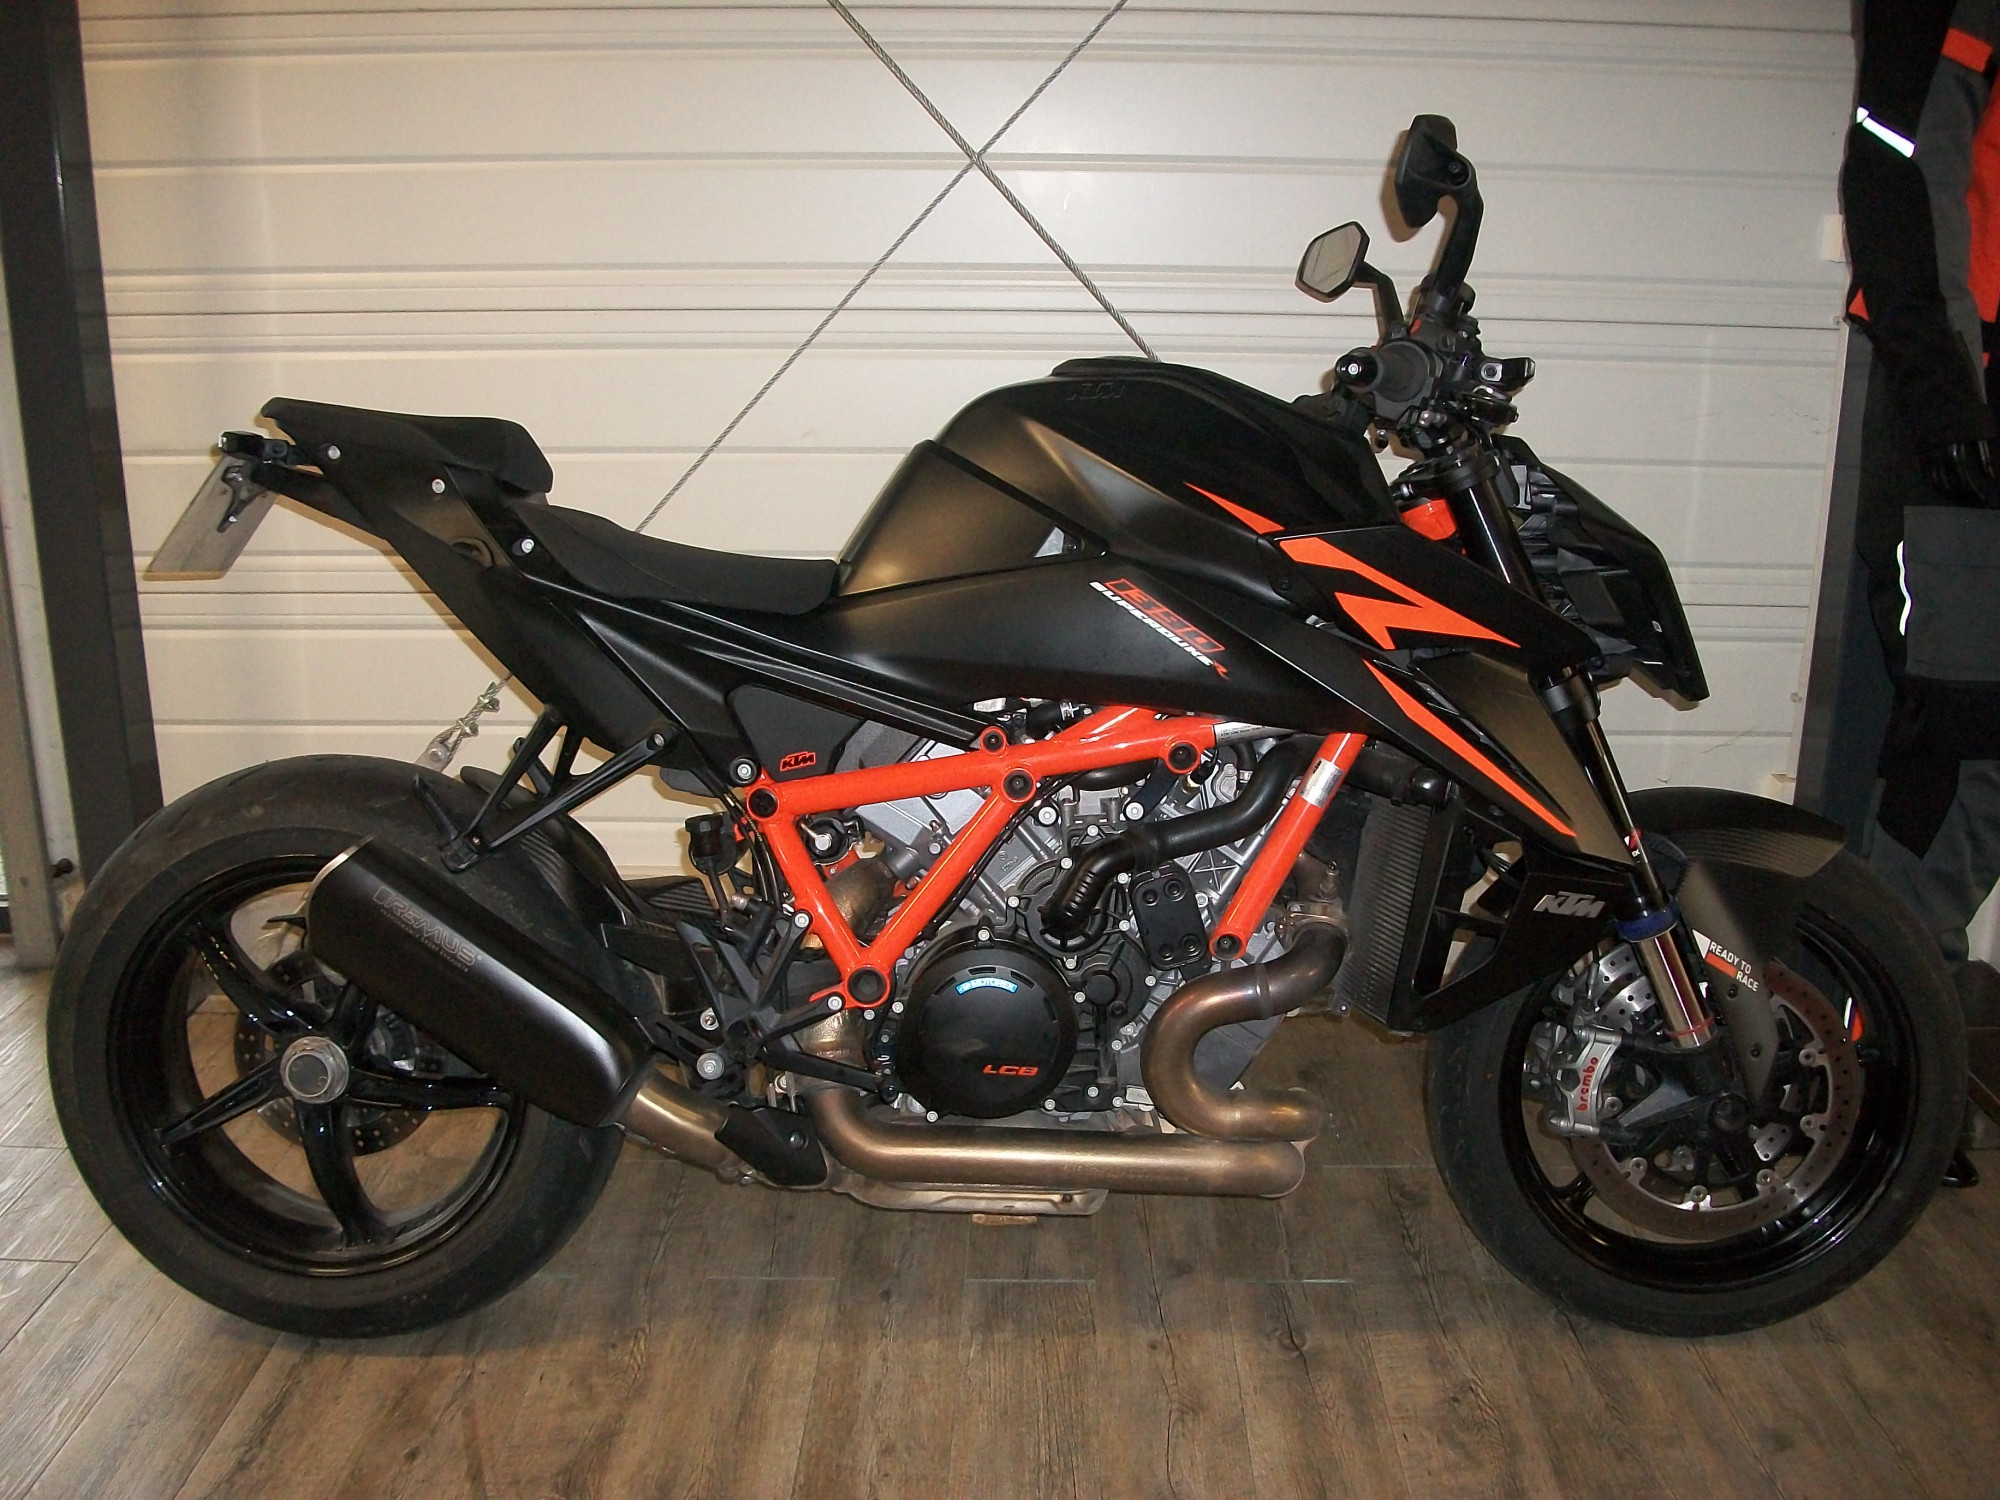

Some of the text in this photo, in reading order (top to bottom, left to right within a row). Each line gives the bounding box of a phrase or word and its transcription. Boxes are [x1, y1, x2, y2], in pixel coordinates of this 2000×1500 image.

[779, 750, 816, 771] KTM
[1532, 890, 1606, 919] KTM
[383, 895, 478, 966] REMUS
[1709, 941, 1752, 975] READY TO
[1736, 970, 1759, 992] RACE
[1576, 1056, 1599, 1111] brembo
